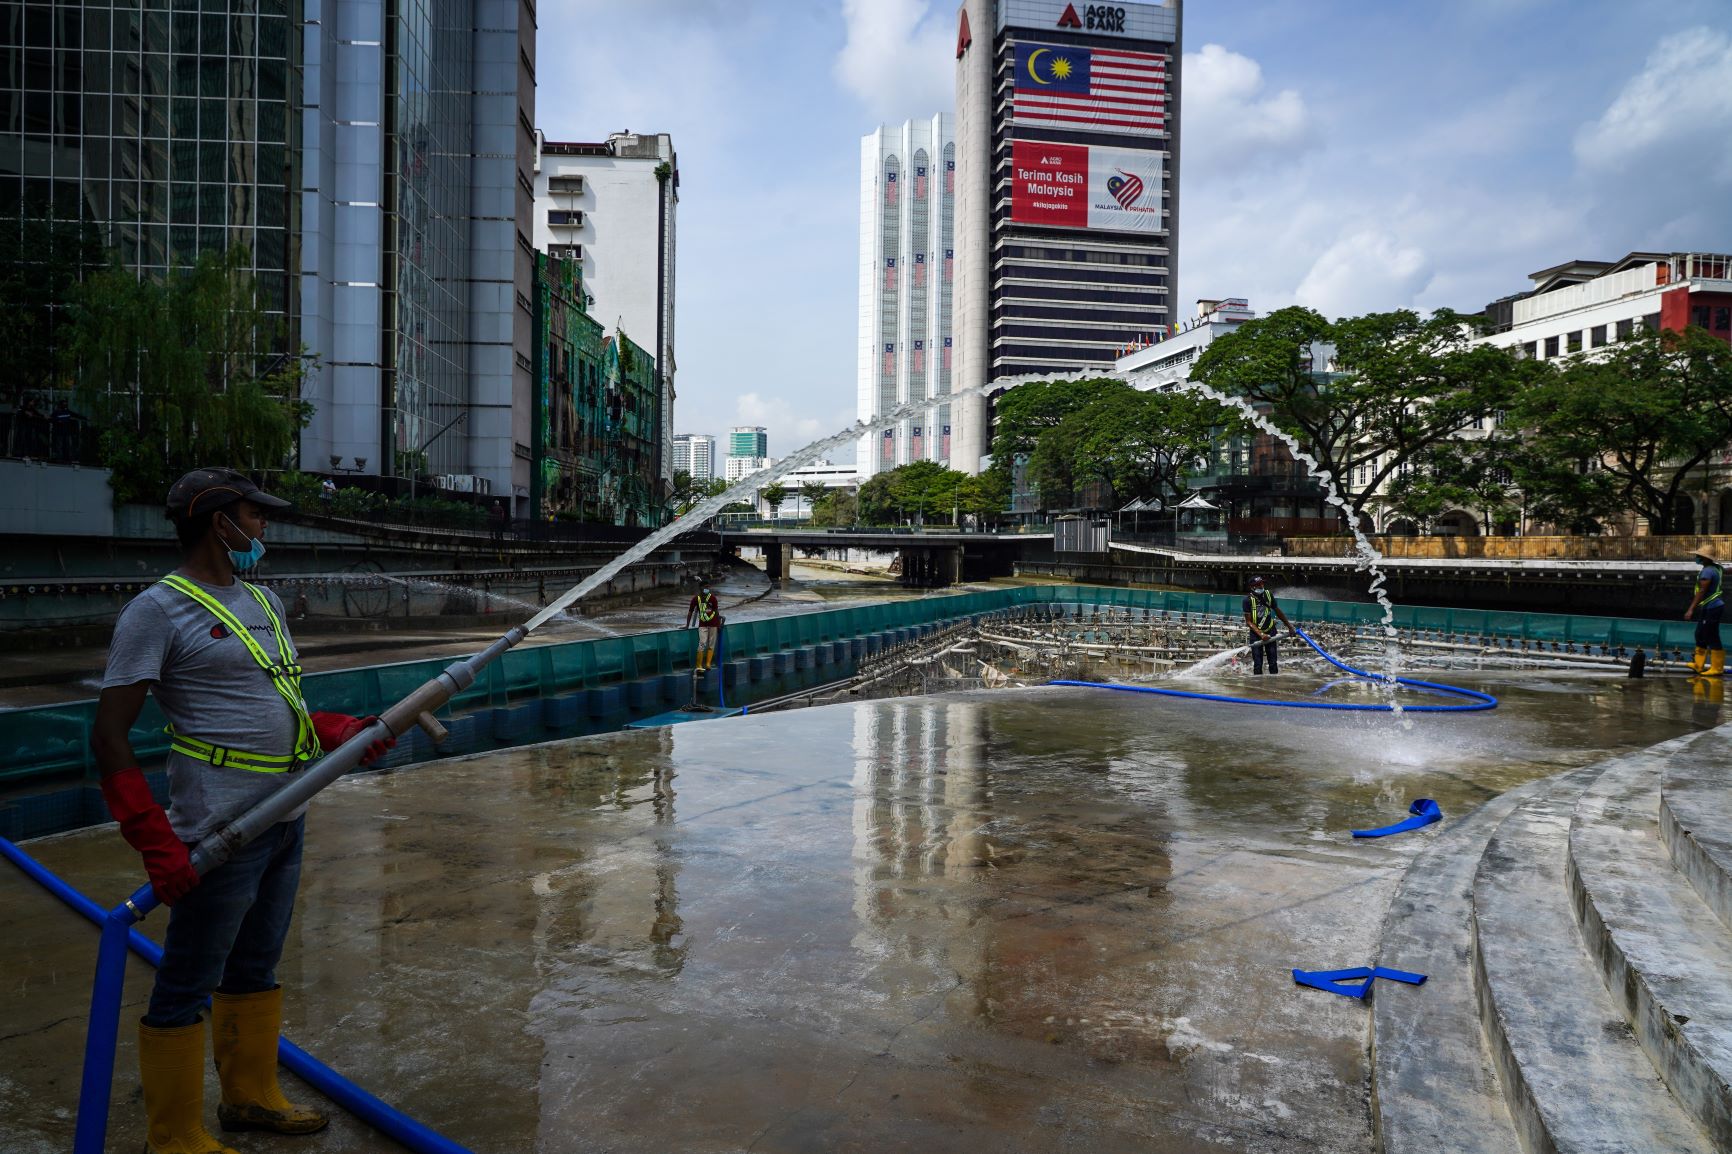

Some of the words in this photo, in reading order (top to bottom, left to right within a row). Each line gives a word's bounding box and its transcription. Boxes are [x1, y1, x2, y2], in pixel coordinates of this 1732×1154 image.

[1086, 4, 1126, 20] AGRO
[1086, 17, 1125, 33] BANK
[1018, 168, 1052, 181] Terima
[1056, 171, 1083, 184] Kasih
[1027, 183, 1074, 197] Malaysia
